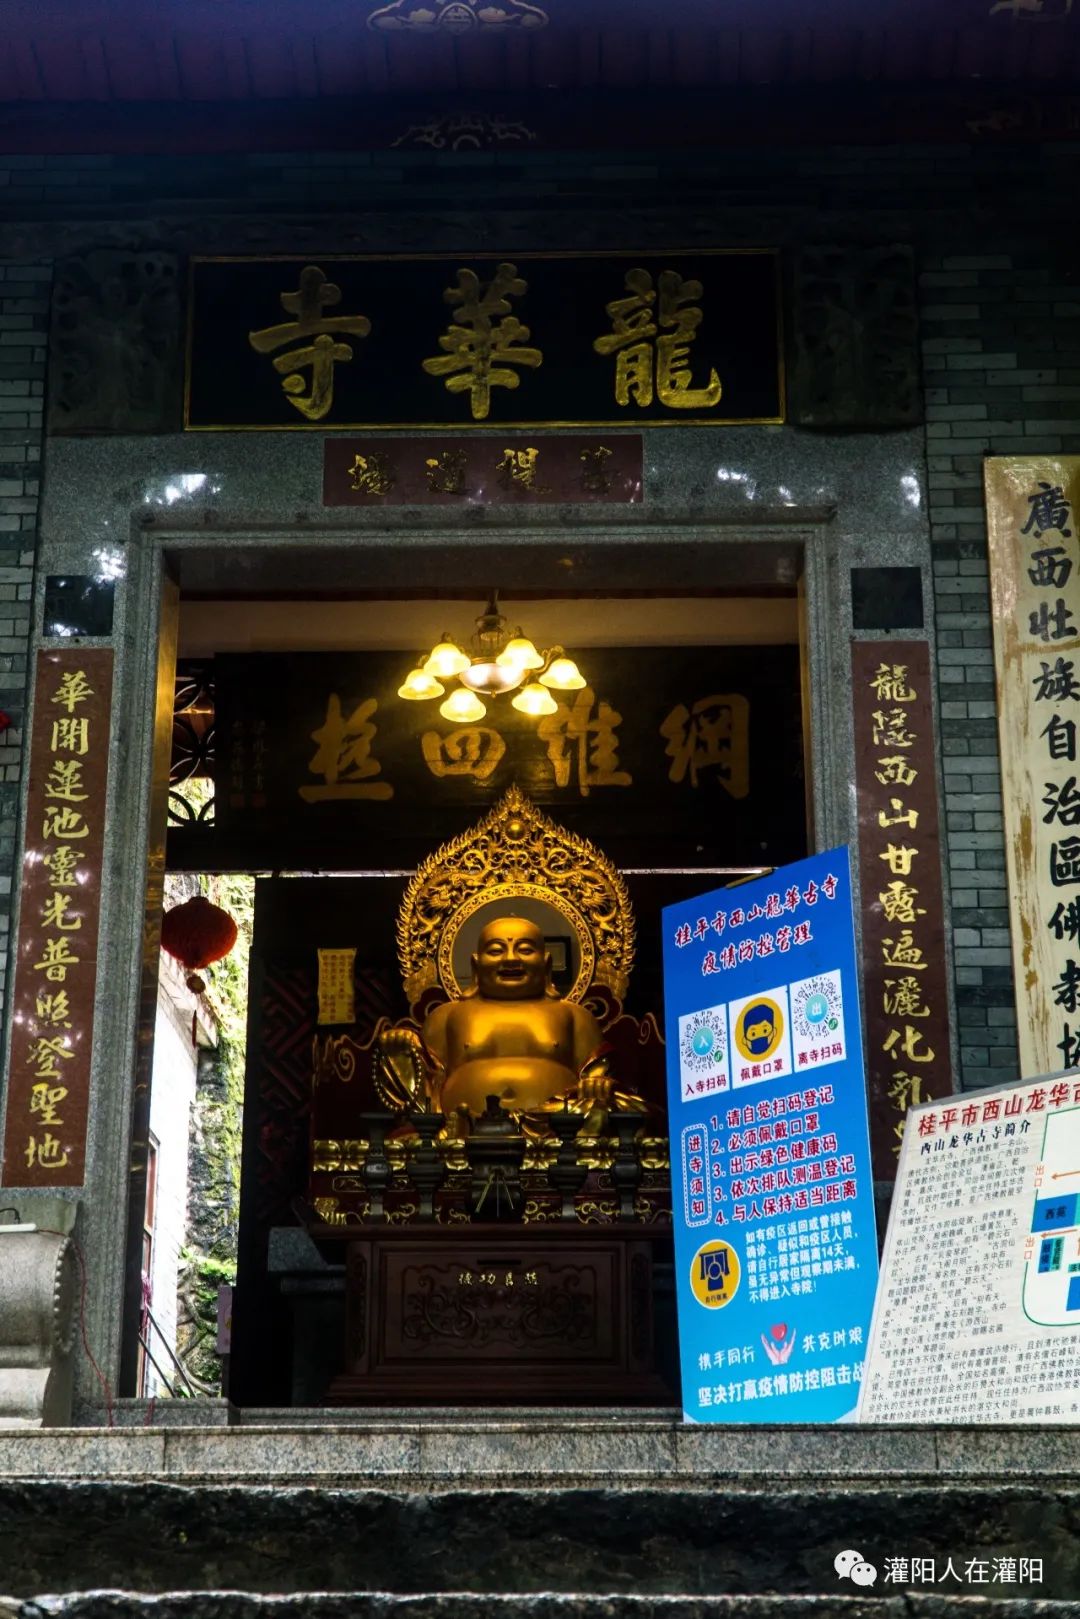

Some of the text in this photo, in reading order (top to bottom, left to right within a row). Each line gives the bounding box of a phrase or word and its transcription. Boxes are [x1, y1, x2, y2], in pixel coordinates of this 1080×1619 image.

[248, 262, 722, 421] 龍華寺
[702, 920, 814, 976] 疫情防控管理
[797, 1043, 843, 1067] 离寺扫码
[740, 1058, 783, 1082] 佩戴口罩
[685, 1074, 727, 1096] 入寺扫码
[920, 1119, 1032, 1156] 西山龙华古寺简介
[688, 1135, 705, 1216] 进寺须知
[1034, 1165, 1045, 1188] 出口
[1024, 1236, 1035, 1261] 出口
[803, 1326, 863, 1353] 共克时艰
[698, 1346, 755, 1372] 携手同行
